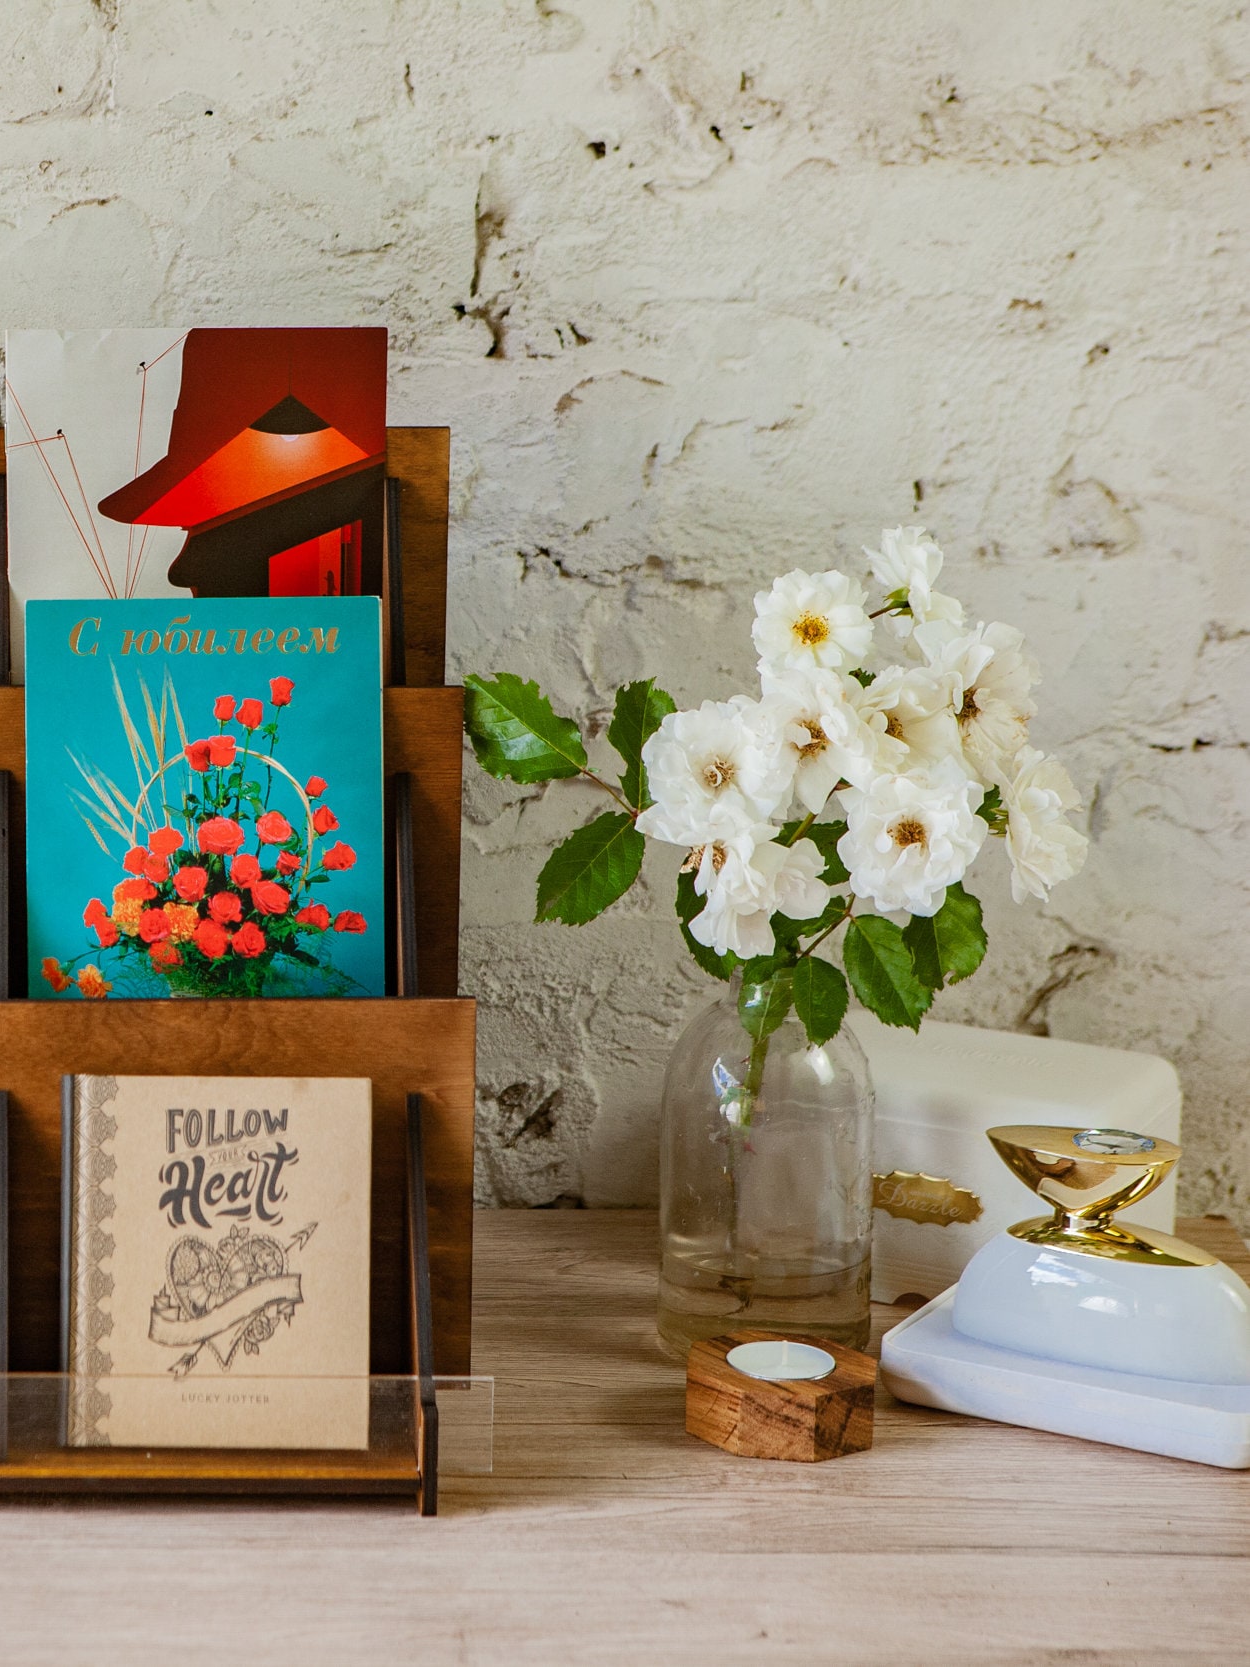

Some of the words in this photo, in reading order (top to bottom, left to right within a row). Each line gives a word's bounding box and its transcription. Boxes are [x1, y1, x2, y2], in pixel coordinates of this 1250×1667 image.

[68, 616, 102, 656] С
[120, 614, 341, 656] юбилеем
[165, 1108, 289, 1154] FOLLOW
[159, 1142, 300, 1229] Heart
[878, 1181, 963, 1218] Dazzle
